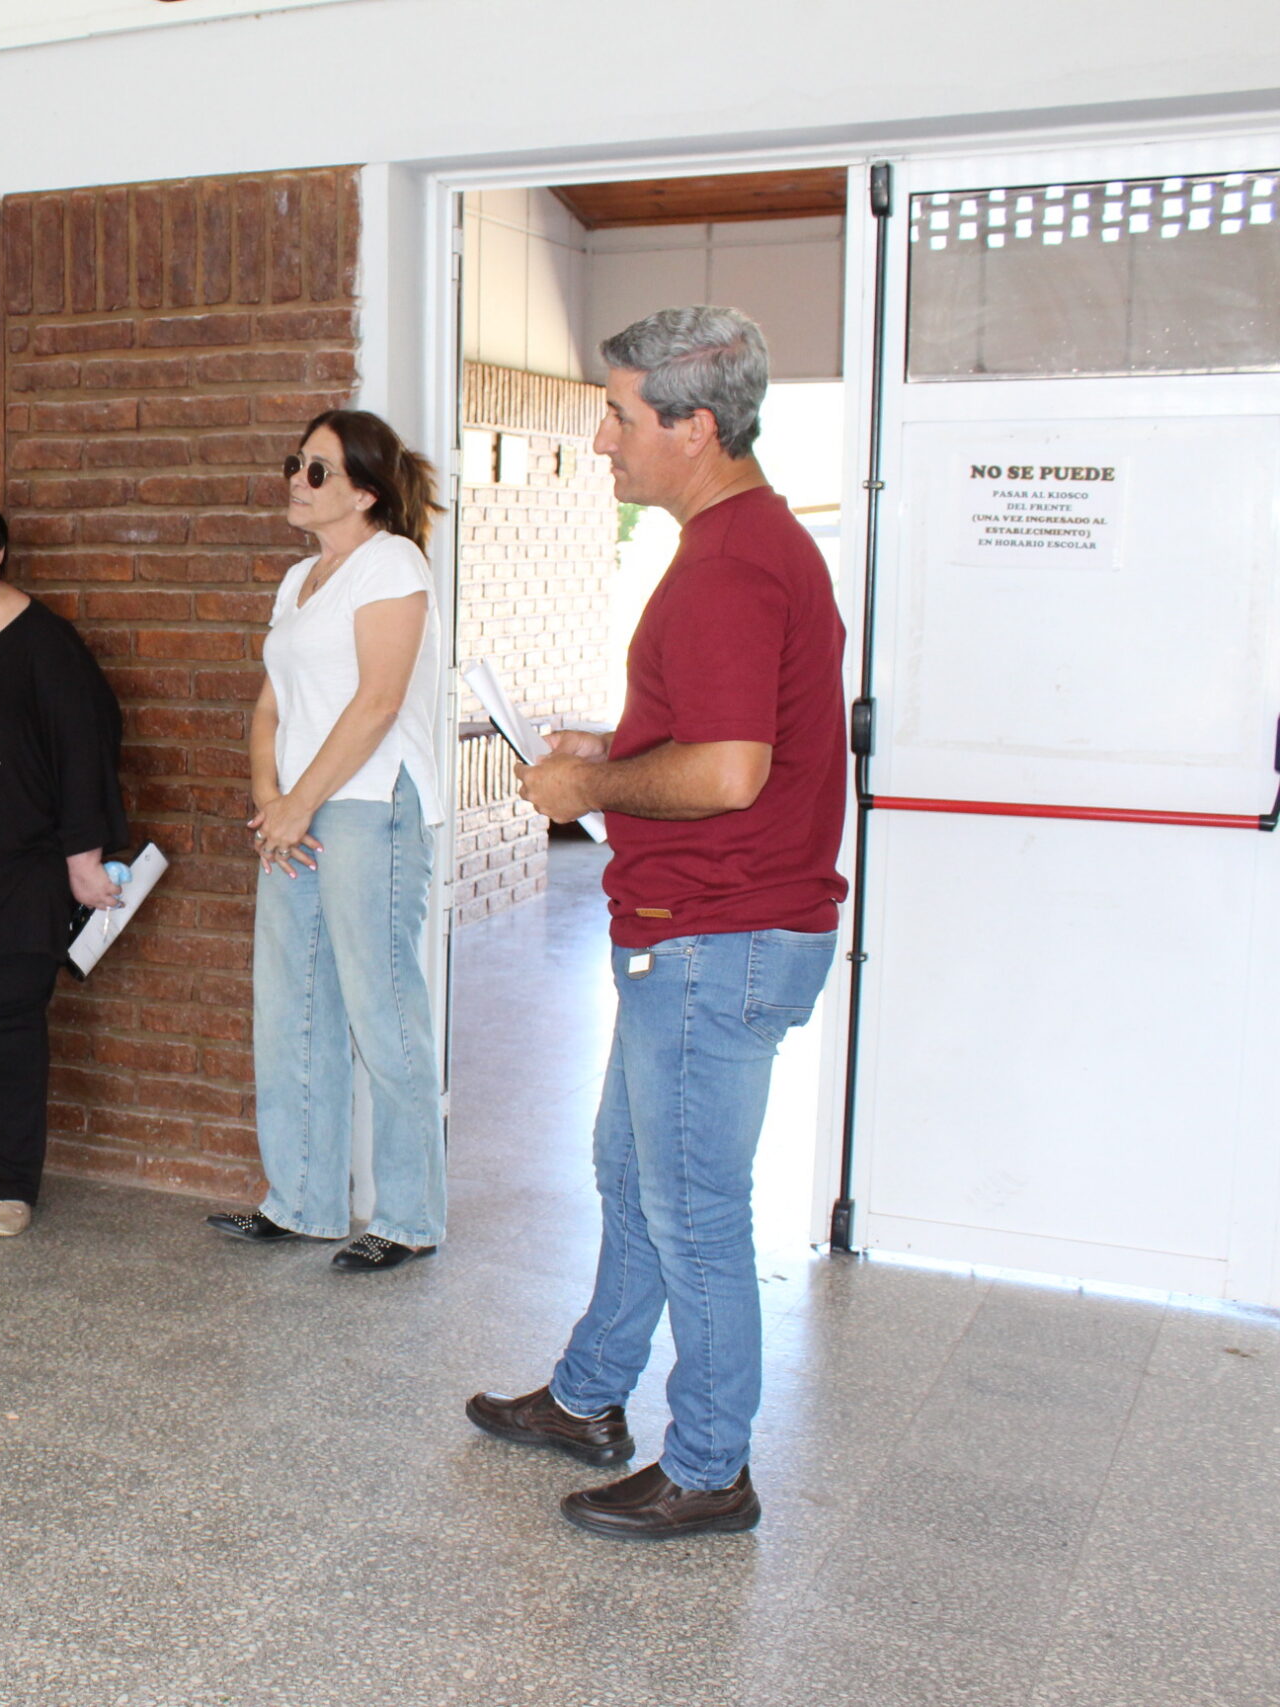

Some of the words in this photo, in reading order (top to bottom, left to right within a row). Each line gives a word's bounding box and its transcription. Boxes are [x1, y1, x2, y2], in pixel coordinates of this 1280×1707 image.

[970, 465, 1002, 479] NO
[1007, 466, 1034, 480] SE
[1040, 466, 1115, 481] PUEDE
[992, 490, 1029, 498] PASAR
[1032, 491, 1045, 499] AL
[1048, 491, 1089, 500] KIOSCO
[1007, 503, 1027, 511] DEL
[1030, 503, 1072, 512] FRENTE
[972, 514, 1000, 522] (UNA
[1003, 515, 1023, 523] VEZ
[1025, 516, 1090, 524] INGRESADO
[1092, 517, 1108, 525] AL
[985, 527, 1091, 538] ESTABLECIMIENTO)
[978, 538, 992, 546] EN
[995, 539, 1045, 548] HORARIO
[1047, 540, 1097, 549] ESCOLAR
